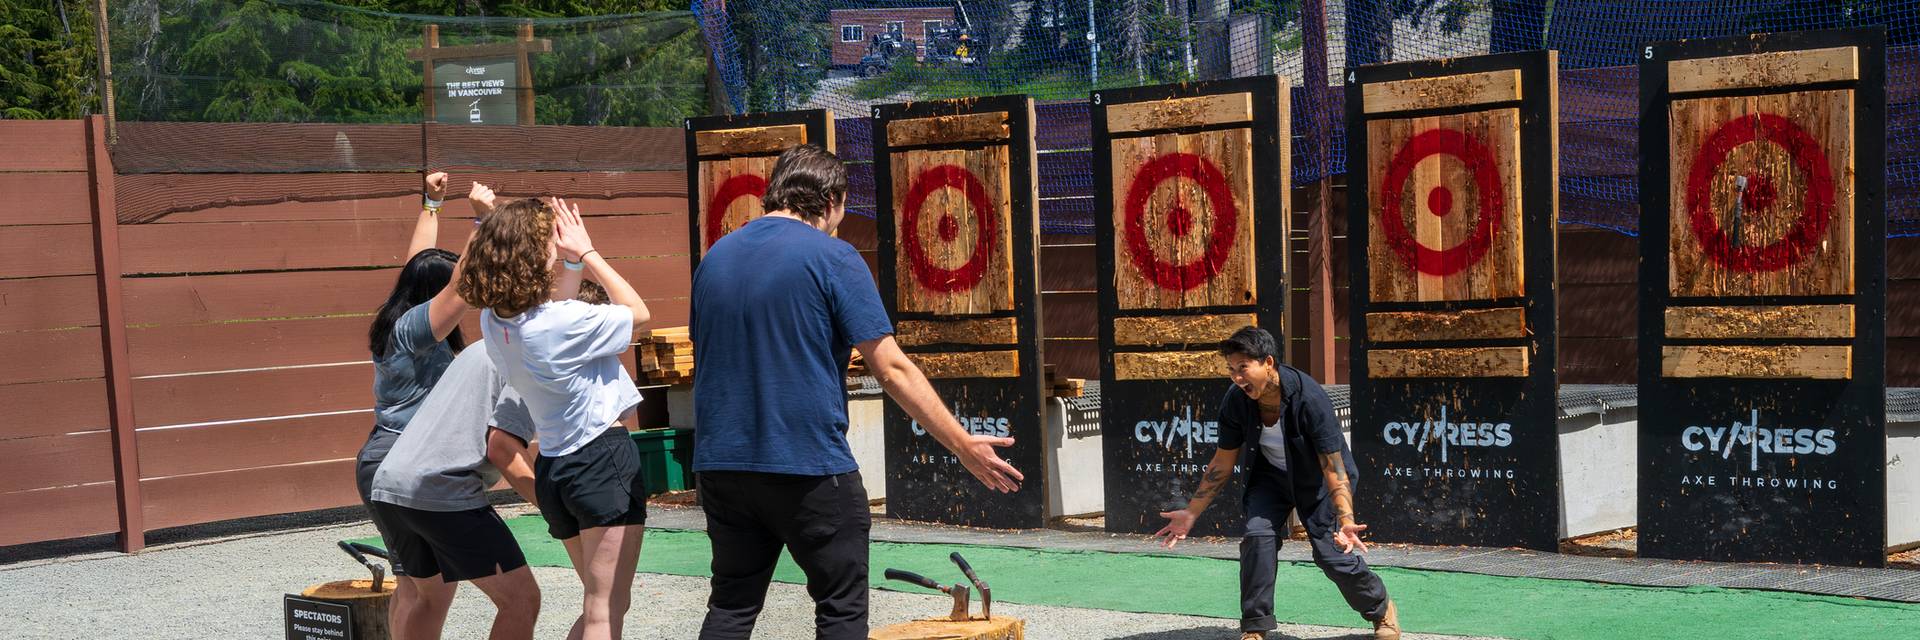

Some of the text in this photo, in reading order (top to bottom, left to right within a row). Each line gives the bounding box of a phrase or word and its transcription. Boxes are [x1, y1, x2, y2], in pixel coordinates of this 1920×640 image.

[1644, 46, 1653, 59] 5
[1348, 71, 1356, 84] 4
[446, 79, 505, 90] THE BEST VIEWS
[448, 88, 503, 98] IN VANCOUVER
[1094, 93, 1101, 104] 3
[874, 108, 881, 119] 2
[685, 119, 690, 130] 1
[1135, 414, 1219, 449] CYPRE
[1135, 463, 1162, 472] AXE
[1384, 467, 1514, 479] AXE THROWING
[1681, 475, 1837, 490] AXE THROWING
[294, 609, 342, 624] SPECTATORS
[293, 623, 344, 638] Please stay behind
